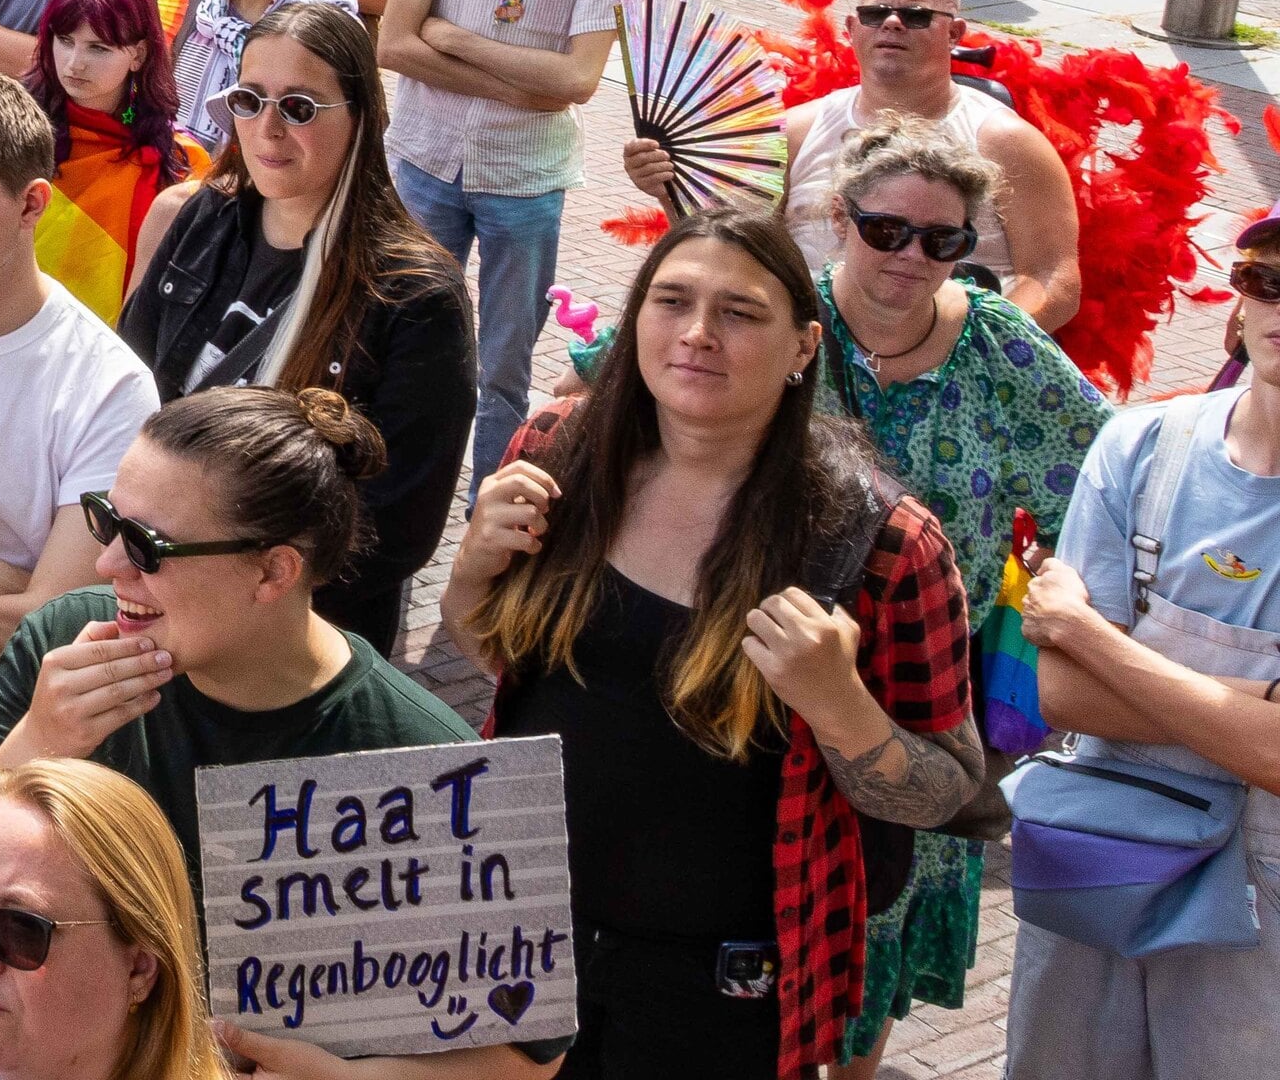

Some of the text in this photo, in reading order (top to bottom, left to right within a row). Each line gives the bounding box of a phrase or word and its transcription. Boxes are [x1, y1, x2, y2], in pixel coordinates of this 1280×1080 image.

[233, 844, 515, 930] smelt in
[236, 925, 568, 1027] Regenbooglicht
